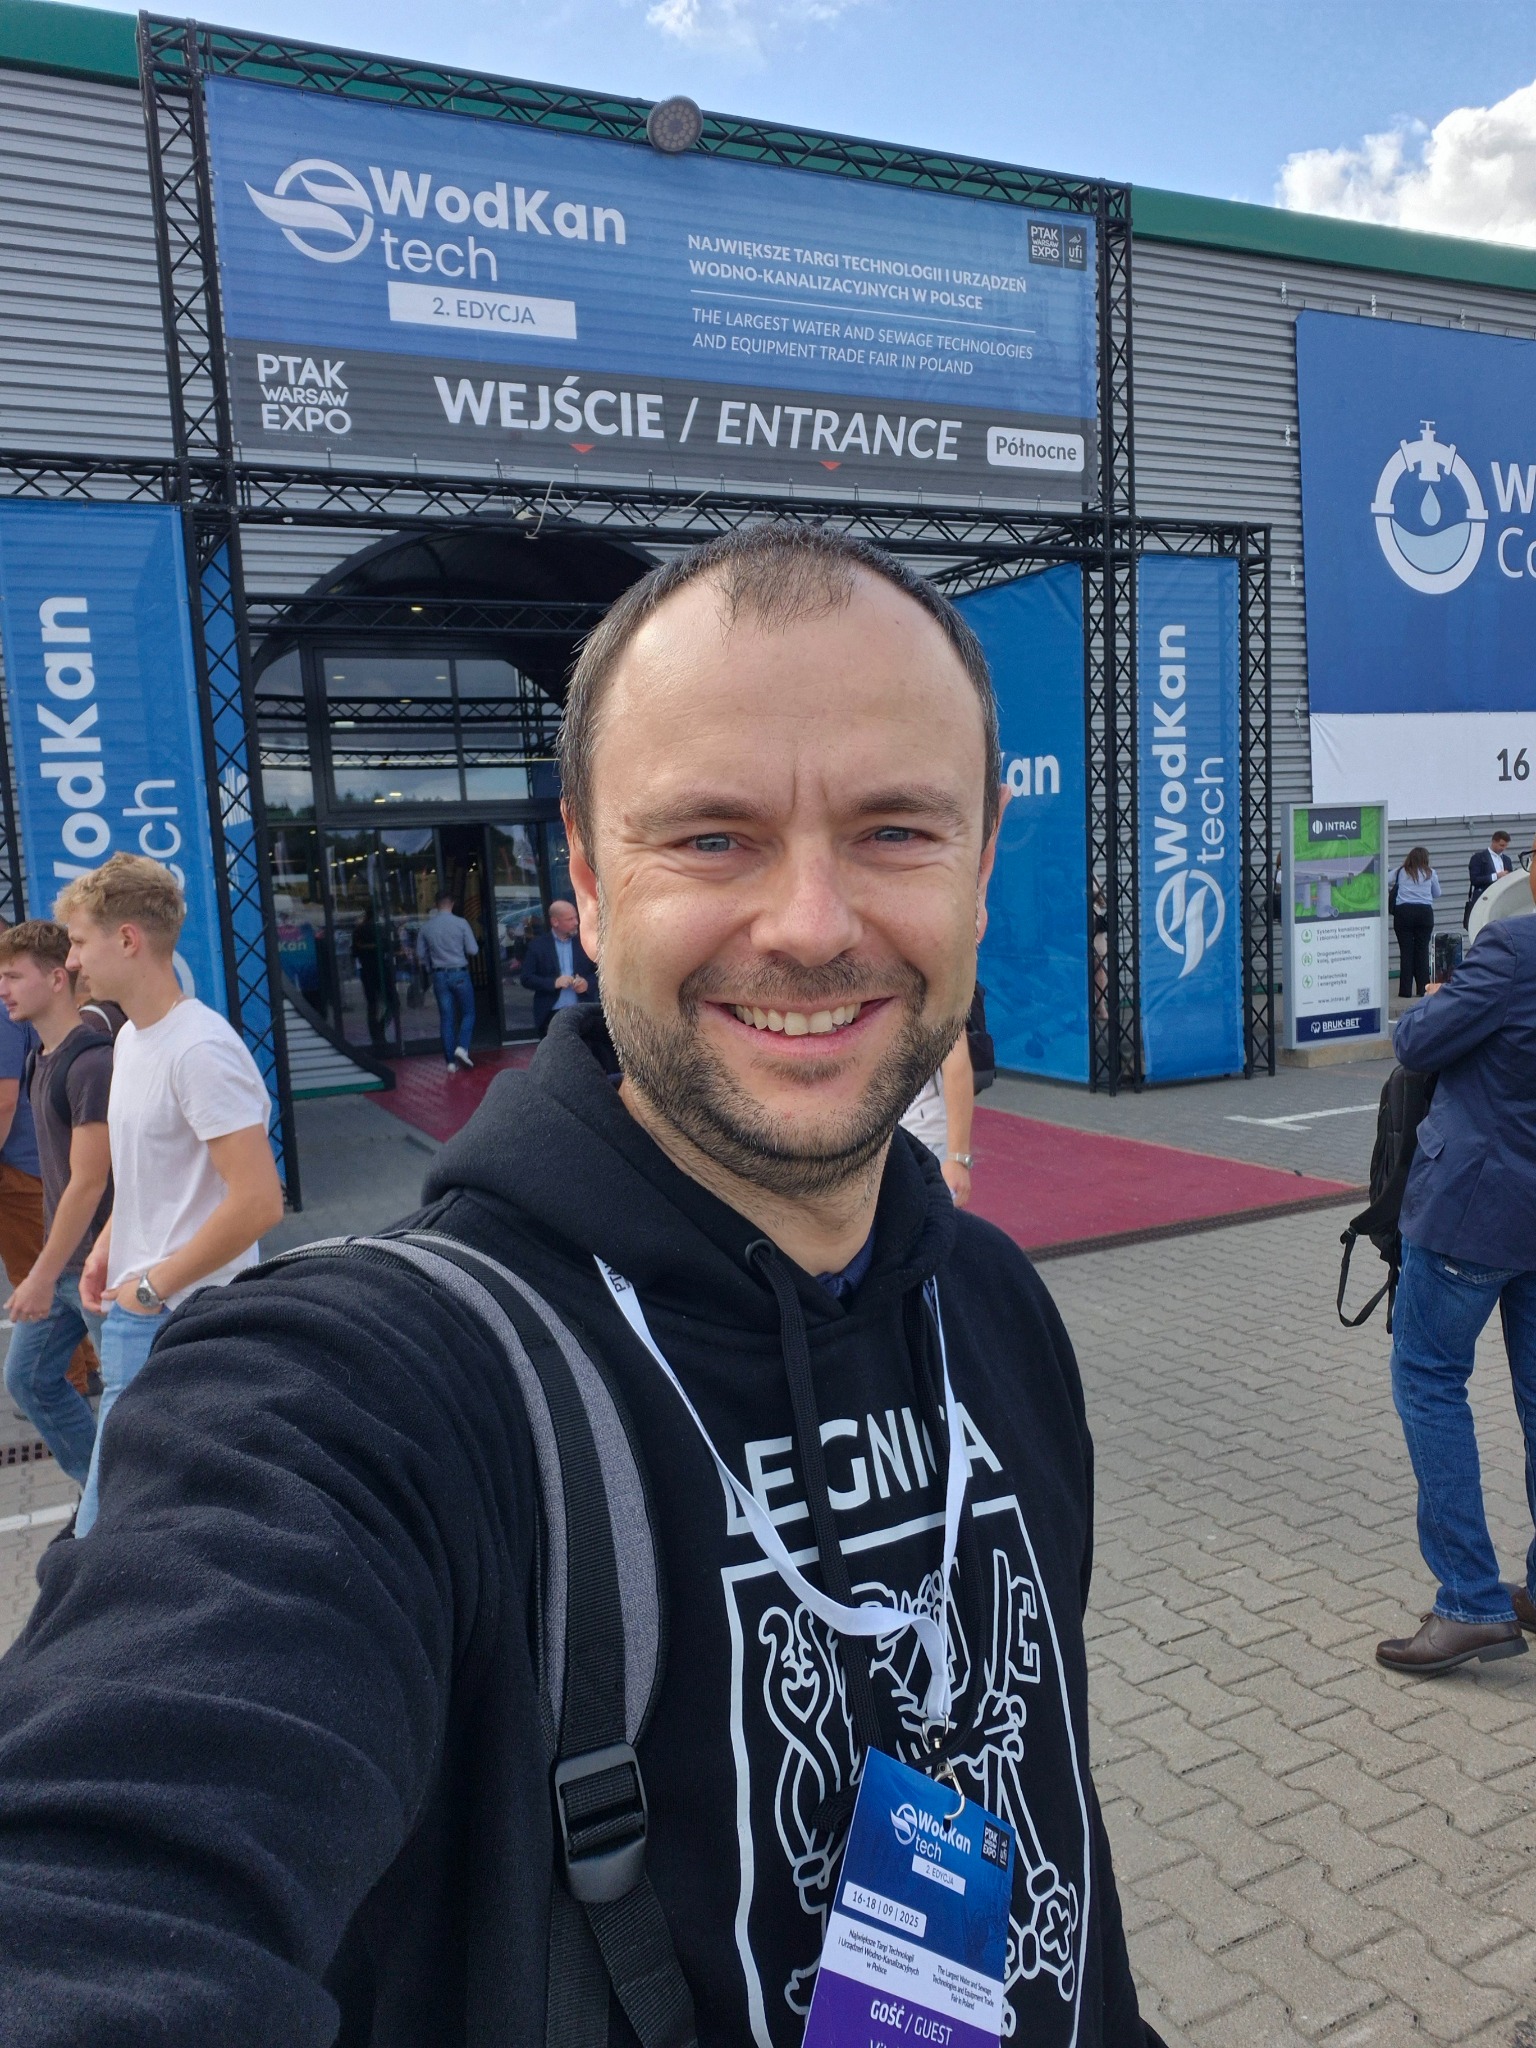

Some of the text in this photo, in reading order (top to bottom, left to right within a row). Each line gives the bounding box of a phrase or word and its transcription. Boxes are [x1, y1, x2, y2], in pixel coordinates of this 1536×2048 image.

[368, 166, 627, 245] WodKan
[1031, 225, 1059, 241] PTAK
[380, 229, 498, 281] tech
[688, 234, 1027, 293] NAJWIĘKSZE TARGI TECHNOLOGII I URZĄDZEŃ
[1032, 245, 1060, 259] EXPO
[1069, 245, 1083, 259] ufi
[689, 259, 983, 310] WODNO-KANALIZACYJNYCH W POLSCE
[432, 297, 536, 325] 2. EDYCJA
[692, 307, 1033, 359] THE LARGEST WATER AND SEWAGE TECHNOLOGIES
[692, 332, 973, 375] AND EQUIPMENT TRADE FAIR IN POLAND
[257, 354, 349, 389] PTAK
[260, 384, 349, 407] WARSAW
[261, 403, 352, 434] EXPO
[433, 375, 665, 439] WEJŚCIE
[717, 401, 962, 461] ENTRANCE
[995, 435, 1078, 462] Północne
[37, 597, 112, 893] odKan
[1152, 625, 1187, 874] WodKan
[1000, 752, 1060, 797] an
[1497, 748, 1530, 781] 16
[1193, 757, 1225, 864] tech
[1325, 821, 1357, 831] INTRAC
[1322, 1017, 1360, 1030] BRUK-BET
[915, 1834, 942, 1862] tech
[932, 1868, 954, 1885] EDYCJA
[853, 1891, 877, 1909] 16-18
[883, 1903, 893, 1916] 09
[900, 1911, 919, 1928] 2025
[872, 1962, 887, 1975] Polsce
[877, 1940, 888, 1953] Targi
[889, 1943, 915, 1963] Technologii
[870, 2000, 905, 2029] GOŚĆ
[914, 2016, 953, 2046] GUEST
